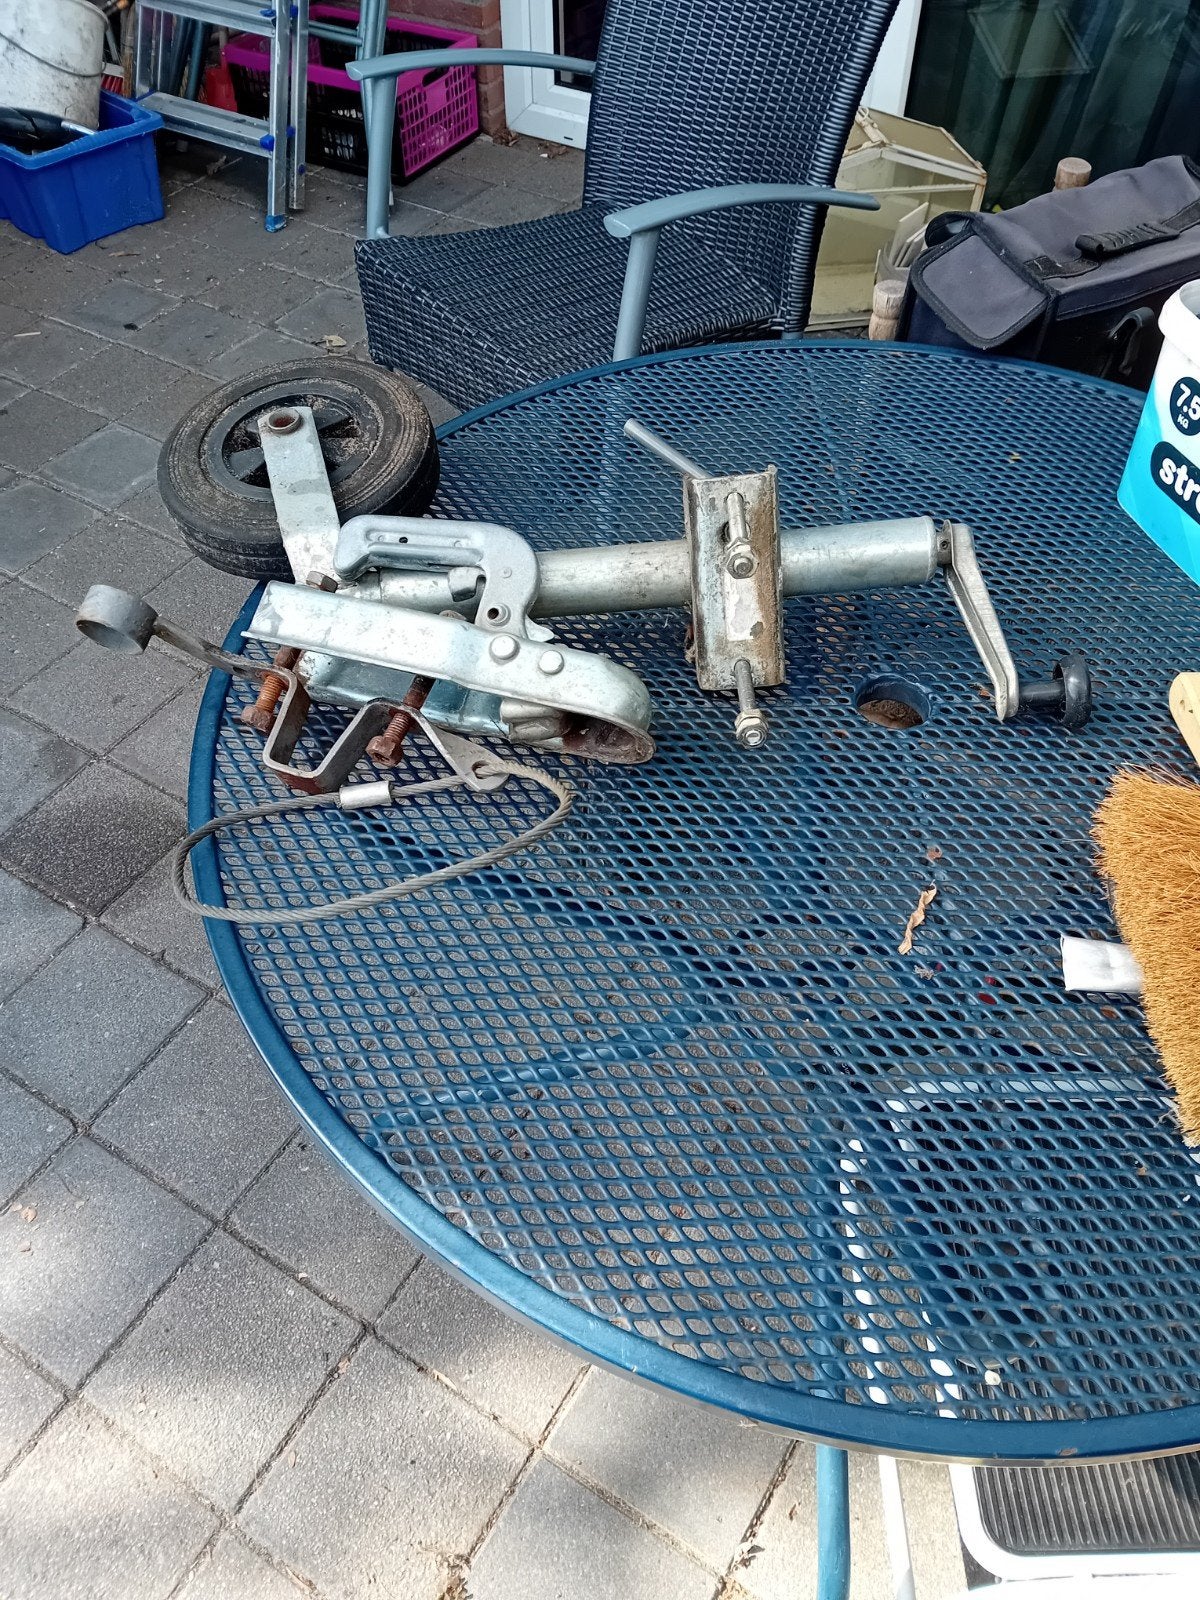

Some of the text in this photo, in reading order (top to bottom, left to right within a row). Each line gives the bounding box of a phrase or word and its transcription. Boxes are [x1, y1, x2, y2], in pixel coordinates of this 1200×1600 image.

[1176, 383, 1200, 421] 7.5
[1177, 413, 1189, 429] KG
[1159, 457, 1200, 515] str
